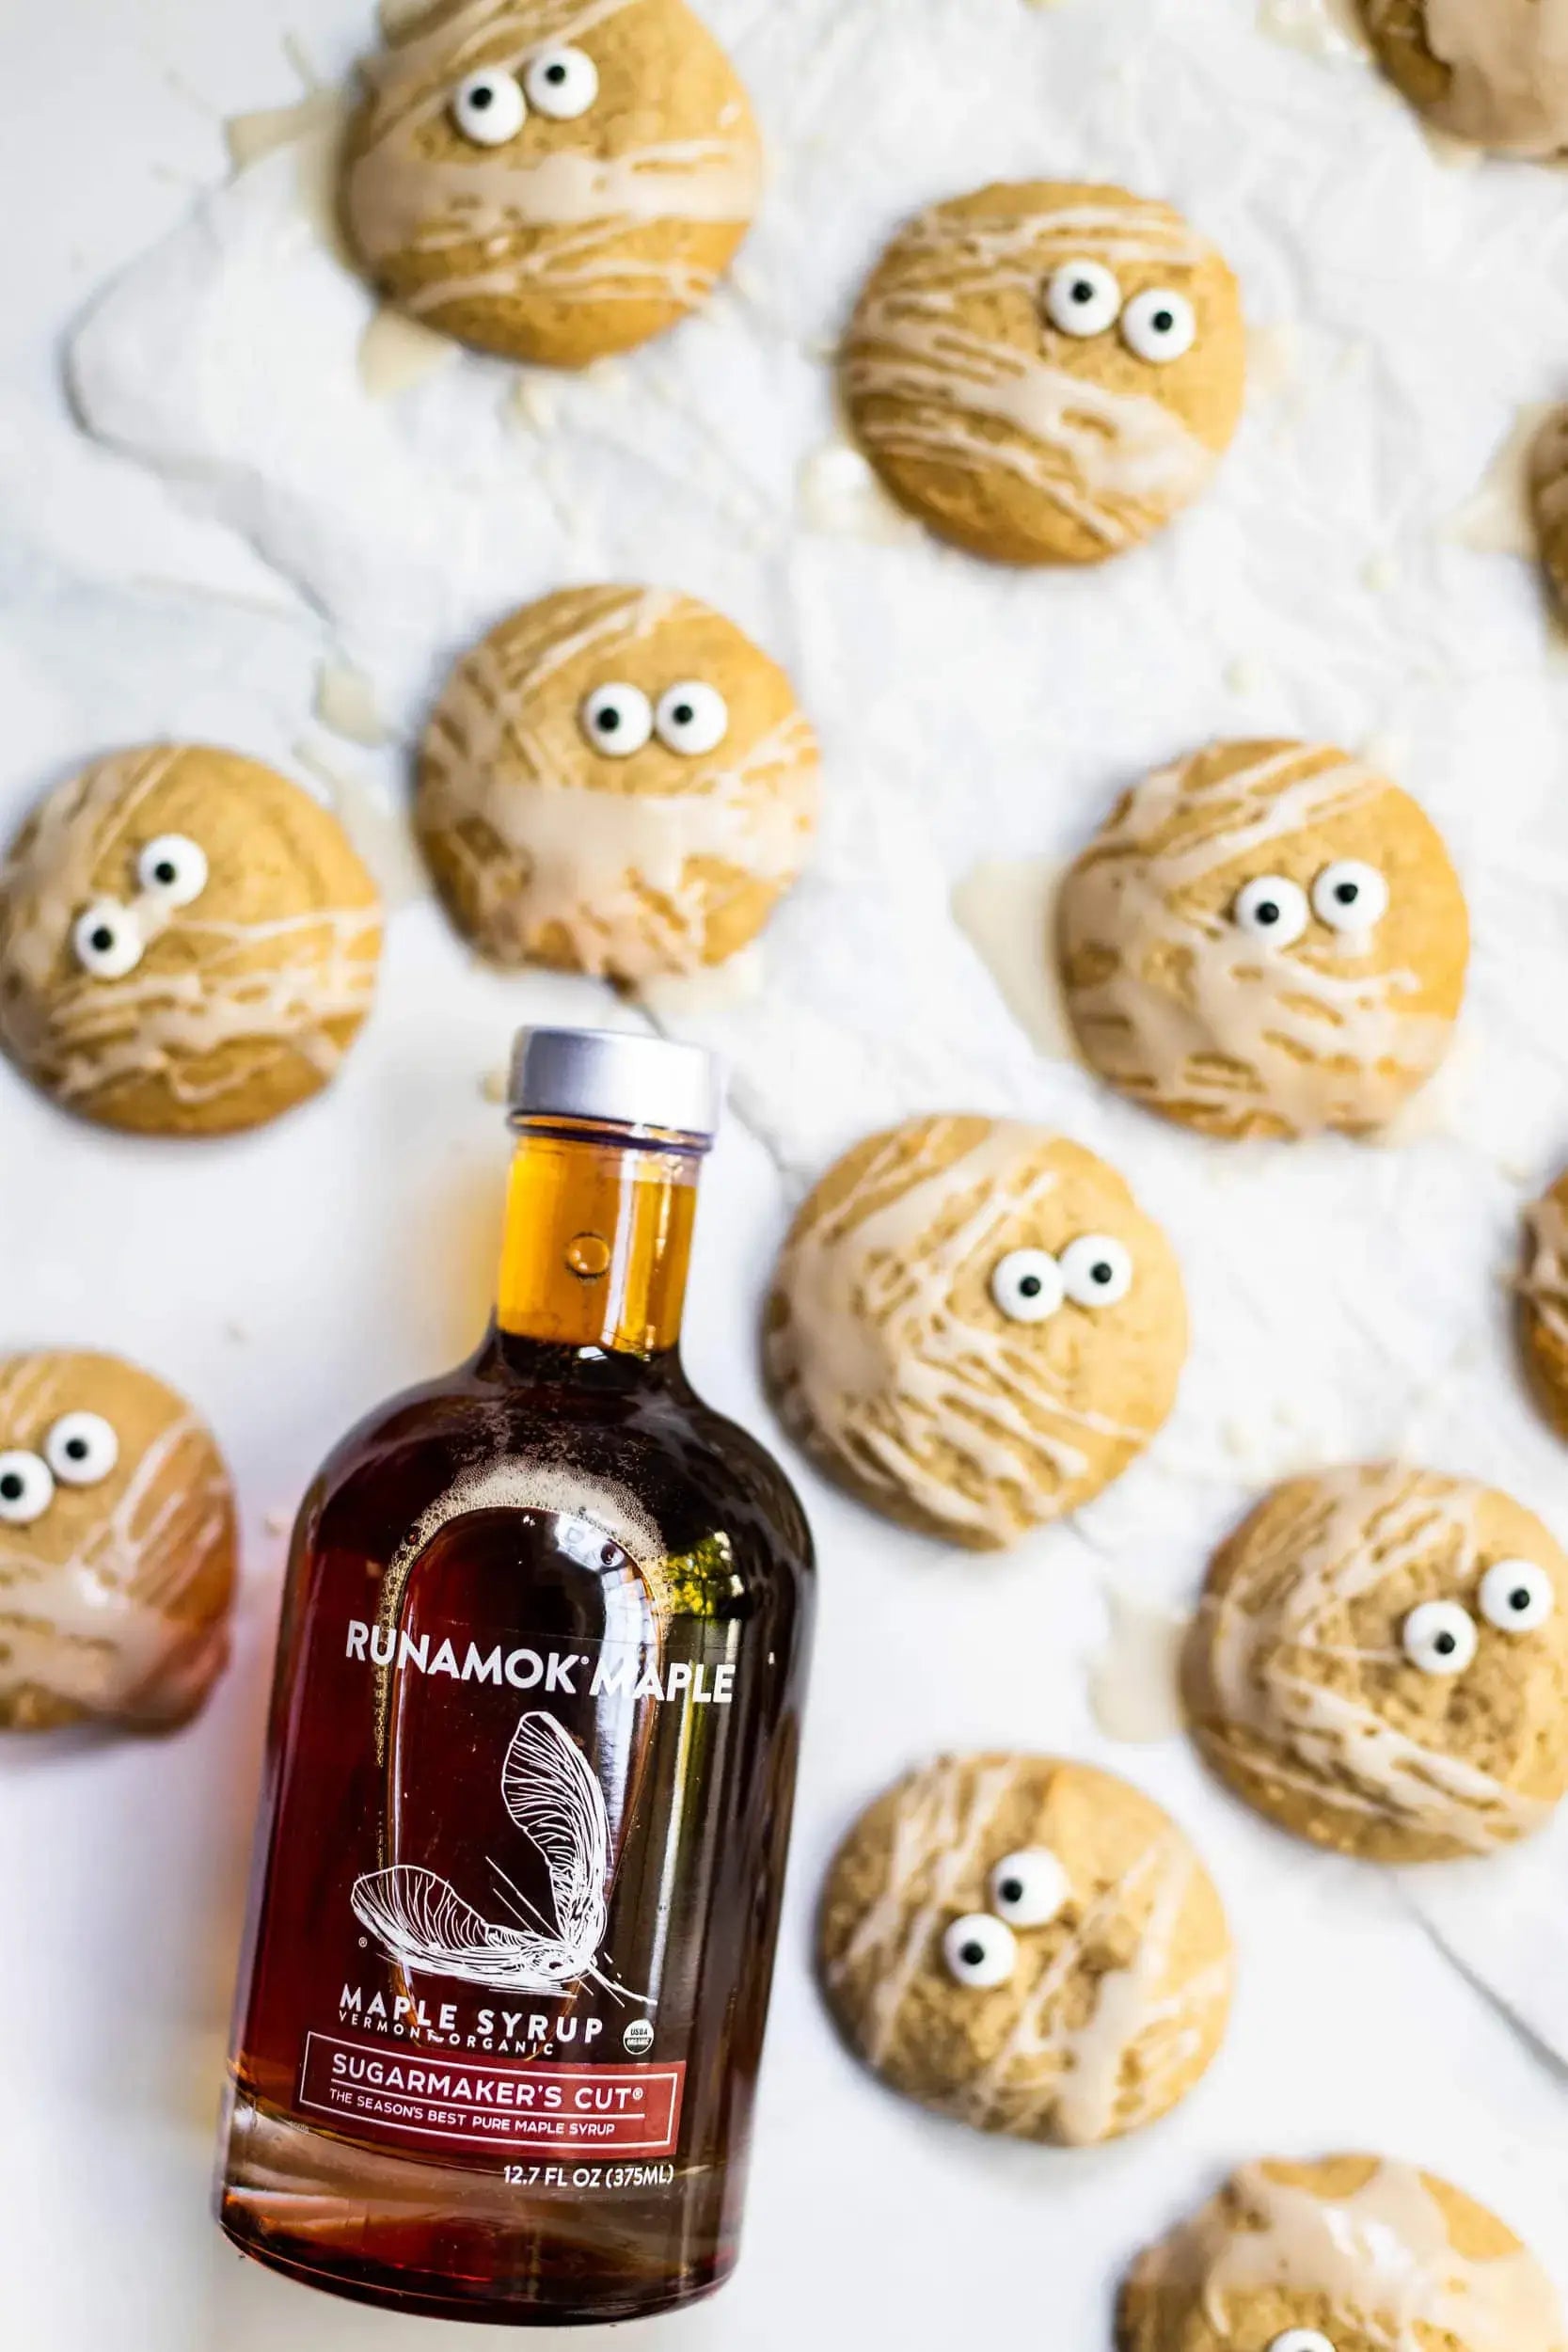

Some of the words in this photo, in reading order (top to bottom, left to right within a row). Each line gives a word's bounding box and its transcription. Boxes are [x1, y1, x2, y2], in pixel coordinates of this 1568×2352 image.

[589, 1657, 736, 1704] MAPLE
[340, 1983, 458, 2030] MAPLE
[476, 2009, 603, 2043] SYRUP
[449, 2033, 553, 2056] ORGANIC
[332, 2053, 562, 2108] SUGARMAKER'S
[329, 2088, 353, 2104] THE
[356, 2095, 423, 2120] SEASON'S
[427, 2110, 467, 2126] BEST
[472, 2116, 510, 2131] PURE
[515, 2120, 564, 2135] MAPLE
[569, 2122, 616, 2136] SYRUP
[503, 2165, 541, 2185] 12.7
[545, 2167, 567, 2187] FL
[572, 2168, 602, 2187] OZ
[605, 2164, 674, 2189] (375ML)
